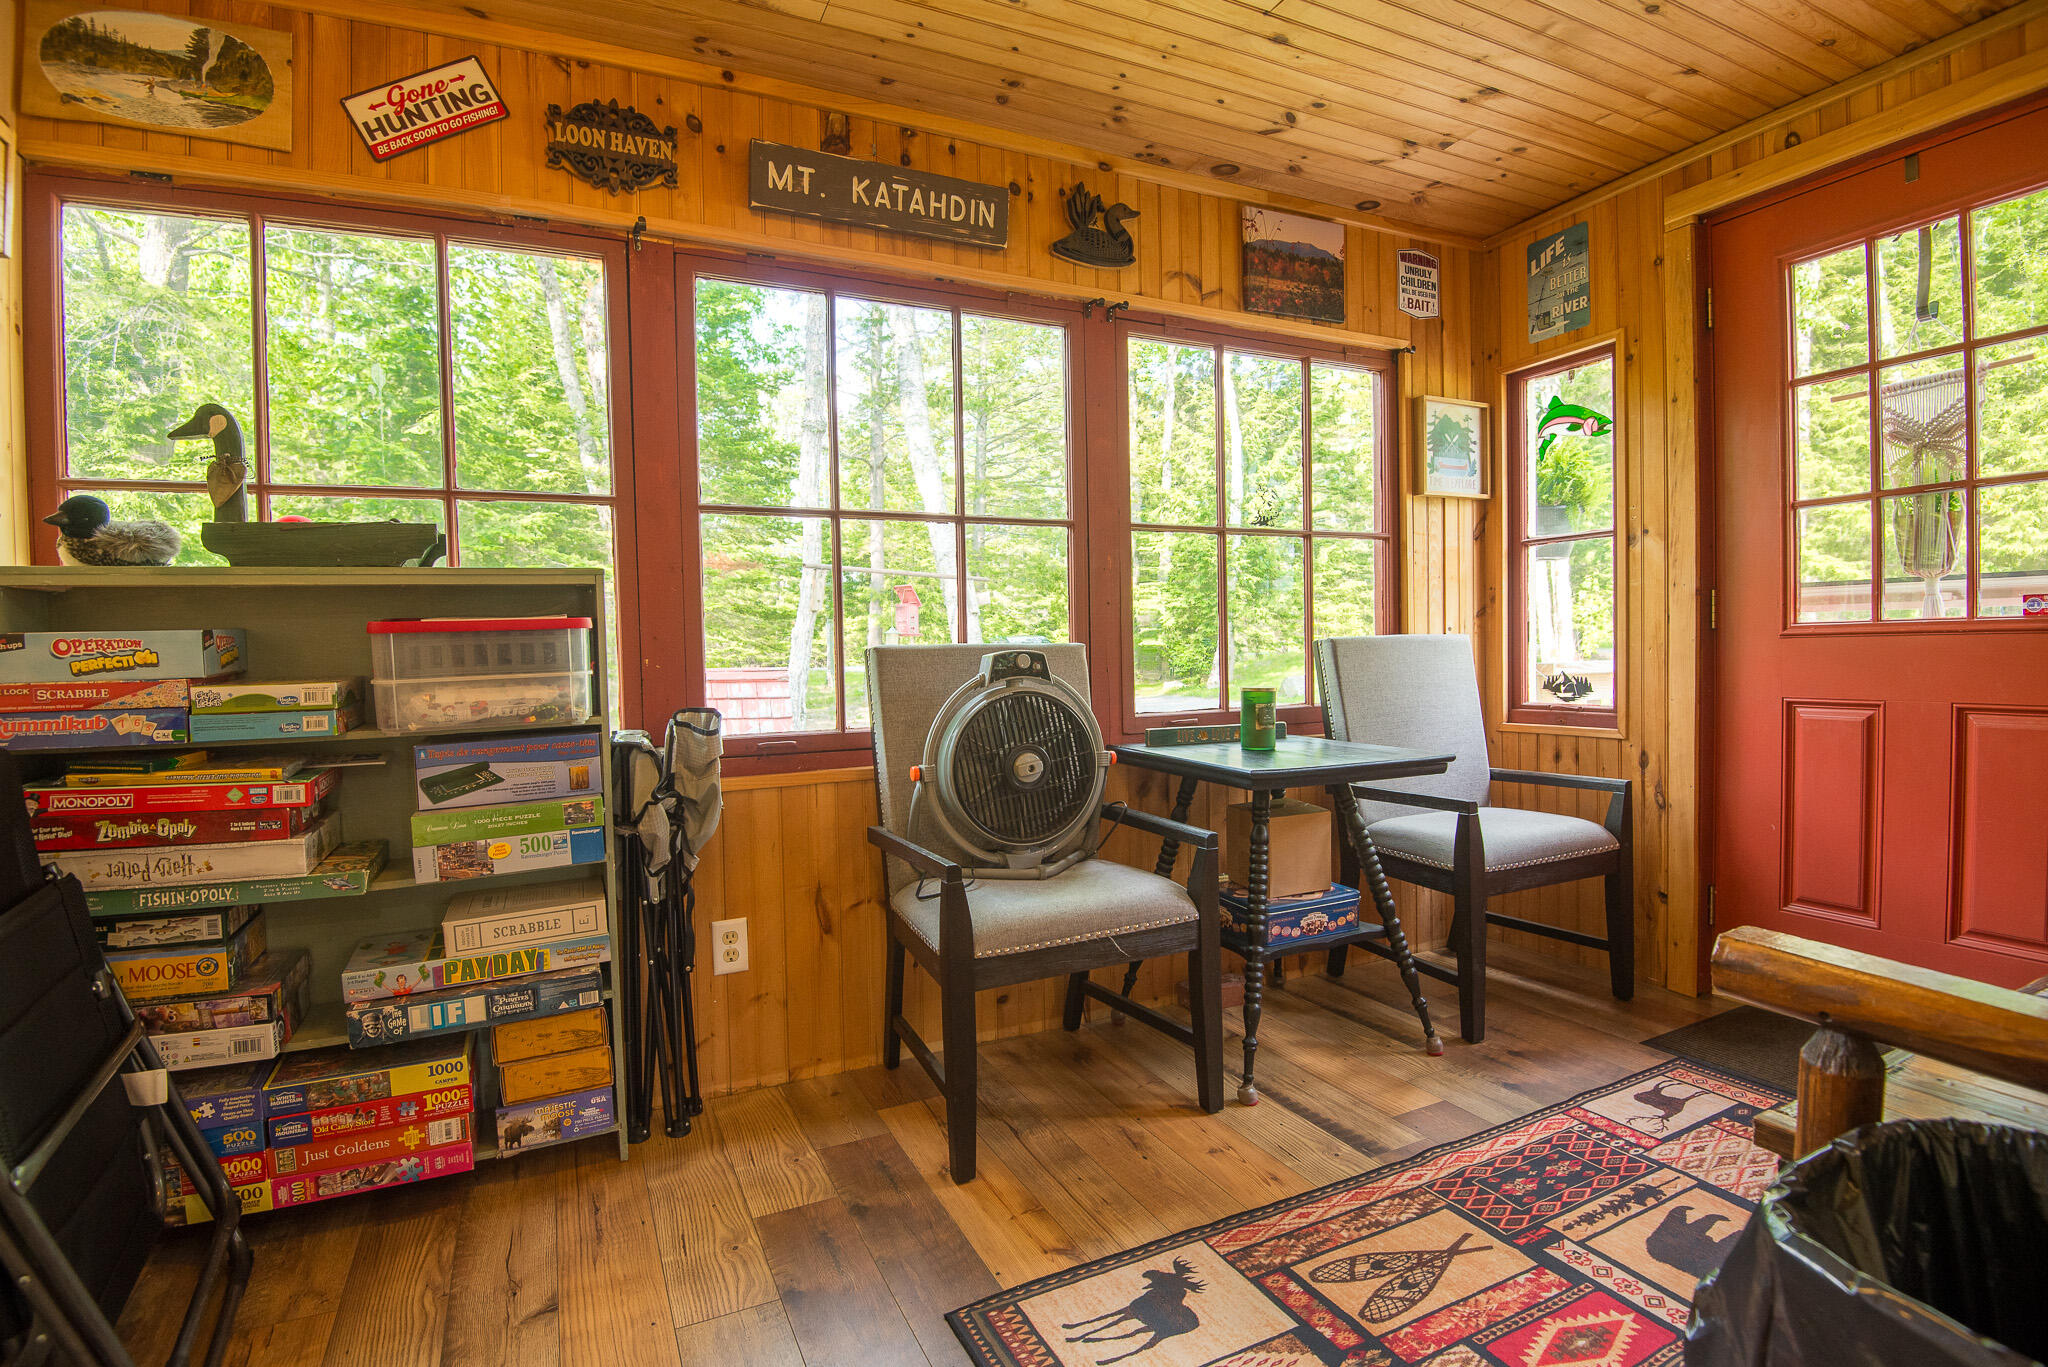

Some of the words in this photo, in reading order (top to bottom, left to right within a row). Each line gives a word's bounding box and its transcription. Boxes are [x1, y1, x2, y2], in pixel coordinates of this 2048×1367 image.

[387, 77, 449, 115] Gone
[362, 83, 491, 141] HUNTING
[377, 144, 389, 155] BE
[390, 134, 413, 152] BACK
[414, 127, 437, 145] SOON
[438, 123, 449, 138] TO
[450, 118, 462, 134] GO
[463, 105, 499, 130] FISHING!
[555, 121, 606, 149] LOON
[610, 131, 673, 160] HAVEN
[768, 160, 826, 198] MT.
[852, 176, 995, 228] KATAHDIN
[1400, 252, 1437, 269] WARNING
[1530, 235, 1566, 277] LIFE
[1562, 252, 1572, 268] is
[1404, 265, 1433, 280] UNRULY
[1550, 266, 1586, 291] BETTER
[1400, 276, 1436, 291] CHILDREN
[1401, 288, 1411, 296] WILL
[1407, 297, 1431, 313] BAIT
[1552, 295, 1588, 319] RIVER
[50, 638, 142, 659] OPERATION
[36, 688, 110, 701] SCRABBLE
[526, 742, 548, 754] pour
[52, 795, 131, 809] MONOPOLY
[492, 814, 513, 823] PIECE
[514, 812, 542, 821] PUZZLE
[96, 820, 148, 844] Zombie
[157, 818, 198, 839] Opoly
[520, 834, 552, 855] 500
[106, 854, 152, 882] Potter
[153, 852, 194, 878] Harry
[139, 887, 234, 908] FISHIN-OPOLY
[493, 918, 562, 940] SCRABBLE
[129, 962, 196, 984] MOOSE
[444, 948, 539, 986] PAYDAY
[392, 1008, 402, 1018] The
[410, 998, 482, 1033] LIF
[427, 1061, 464, 1078] 1000
[270, 1098, 304, 1107] MOUNTAIN
[422, 1088, 461, 1112] 1000
[434, 1098, 470, 1111] PUZZLE
[534, 1100, 577, 1115] MAJESTIC
[540, 1108, 575, 1121] MOOSE
[275, 1128, 309, 1138] MOUNTAIN
[314, 1126, 329, 1134] Old
[330, 1122, 354, 1133] Candy
[355, 1118, 375, 1128] Store
[222, 1130, 257, 1146] 500
[302, 1149, 330, 1166] Just
[334, 1140, 390, 1157] Goldens
[222, 1157, 262, 1176] 1000
[234, 1170, 262, 1178] PUZZLE
